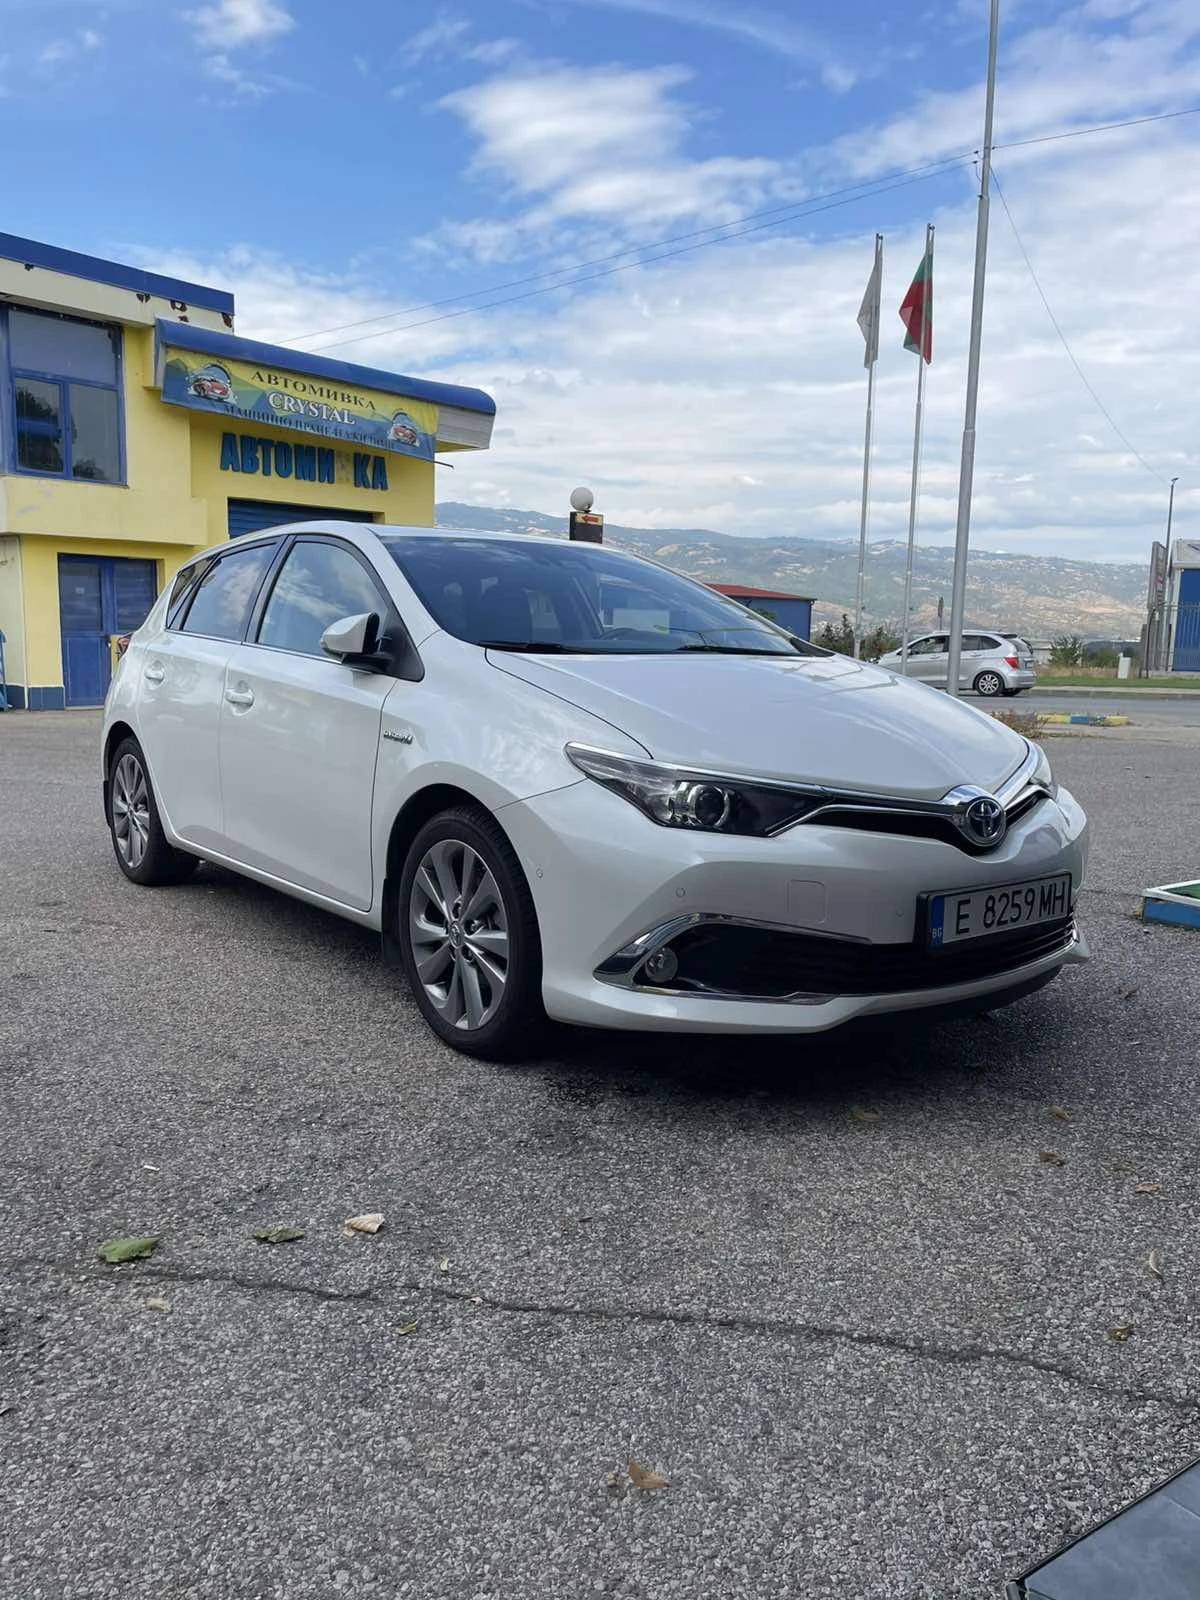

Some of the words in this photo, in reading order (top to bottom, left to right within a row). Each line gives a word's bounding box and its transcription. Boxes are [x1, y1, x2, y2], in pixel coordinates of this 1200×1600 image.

[251, 371, 376, 411] АВТОМИВКА
[268, 391, 356, 425] CRYSTAL
[219, 431, 389, 491] АВТОМИКА
[955, 898, 971, 936] E
[983, 887, 1036, 929] 8259
[1038, 881, 1066, 918] MH
